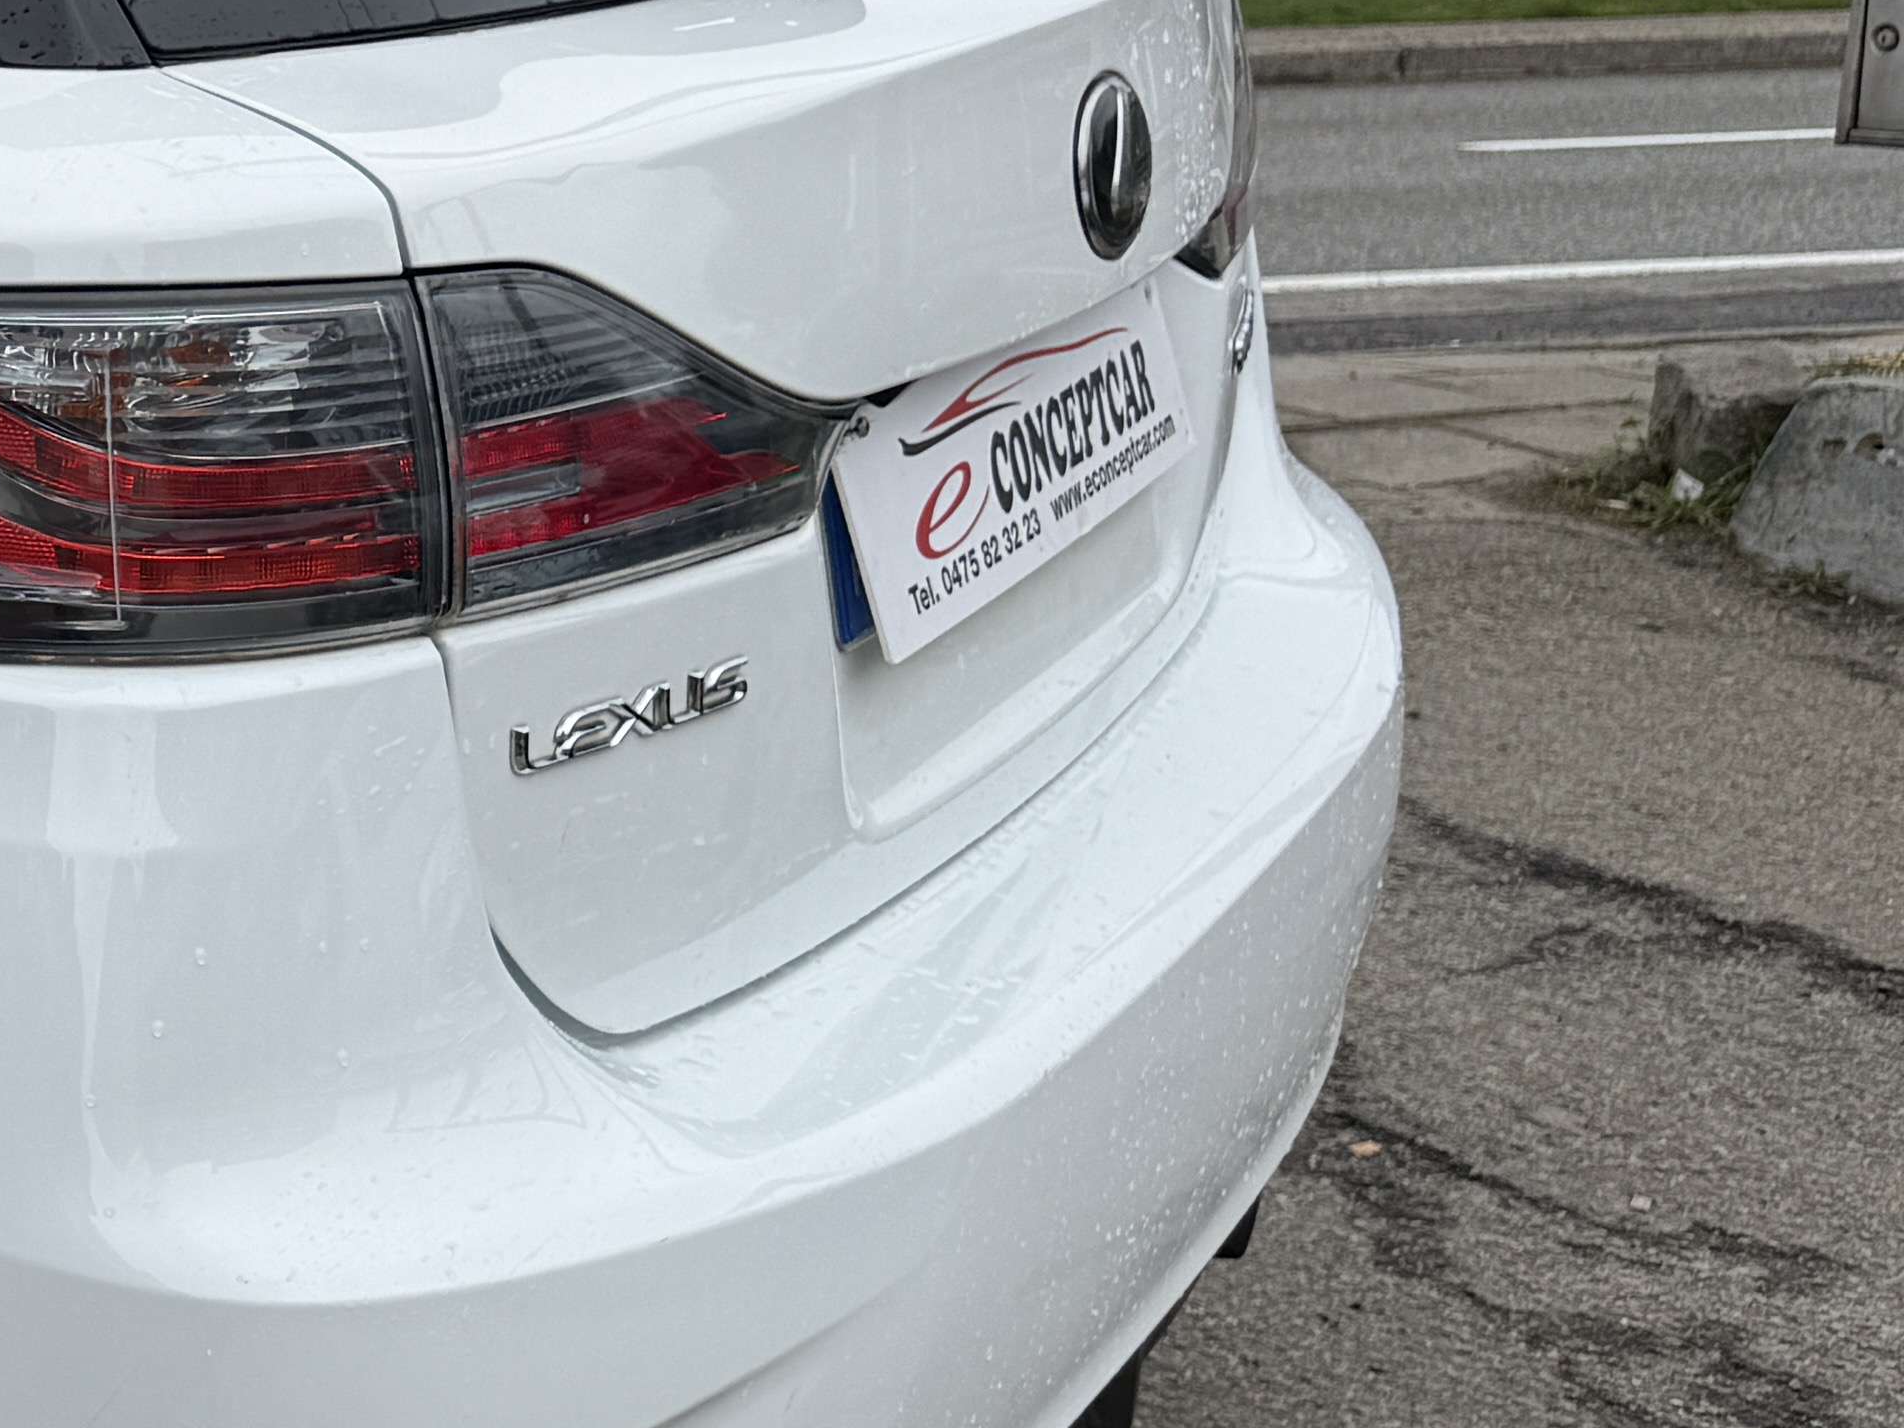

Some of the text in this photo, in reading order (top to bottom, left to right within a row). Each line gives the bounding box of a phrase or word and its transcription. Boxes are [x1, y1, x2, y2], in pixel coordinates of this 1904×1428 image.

[907, 413, 1177, 615] Tel. 0475 82 32 23 www.econceptcar.com
[509, 654, 749, 775] LEXUS
